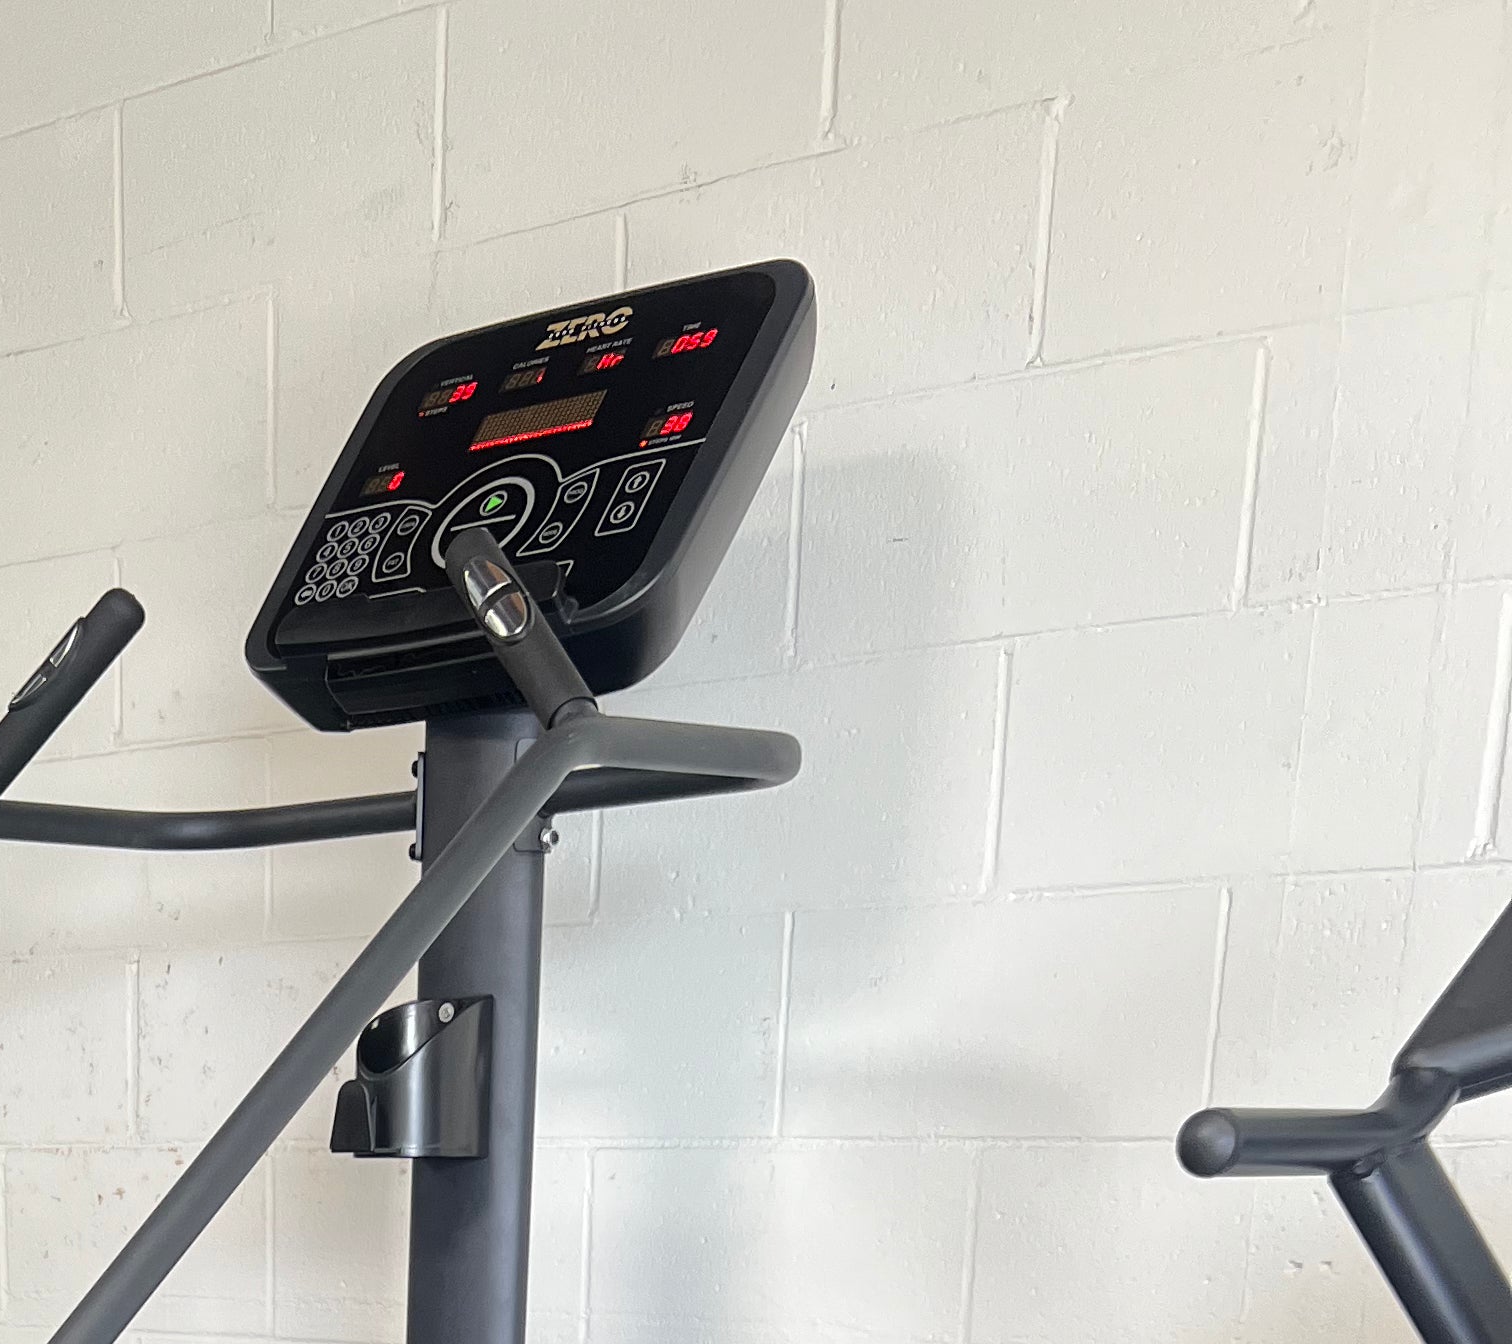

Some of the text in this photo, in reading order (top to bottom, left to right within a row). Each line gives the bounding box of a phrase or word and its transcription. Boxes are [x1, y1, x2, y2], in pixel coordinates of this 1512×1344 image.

[535, 306, 633, 351] ZERO
[612, 337, 633, 347] RATE
[666, 401, 695, 412] SPEED
